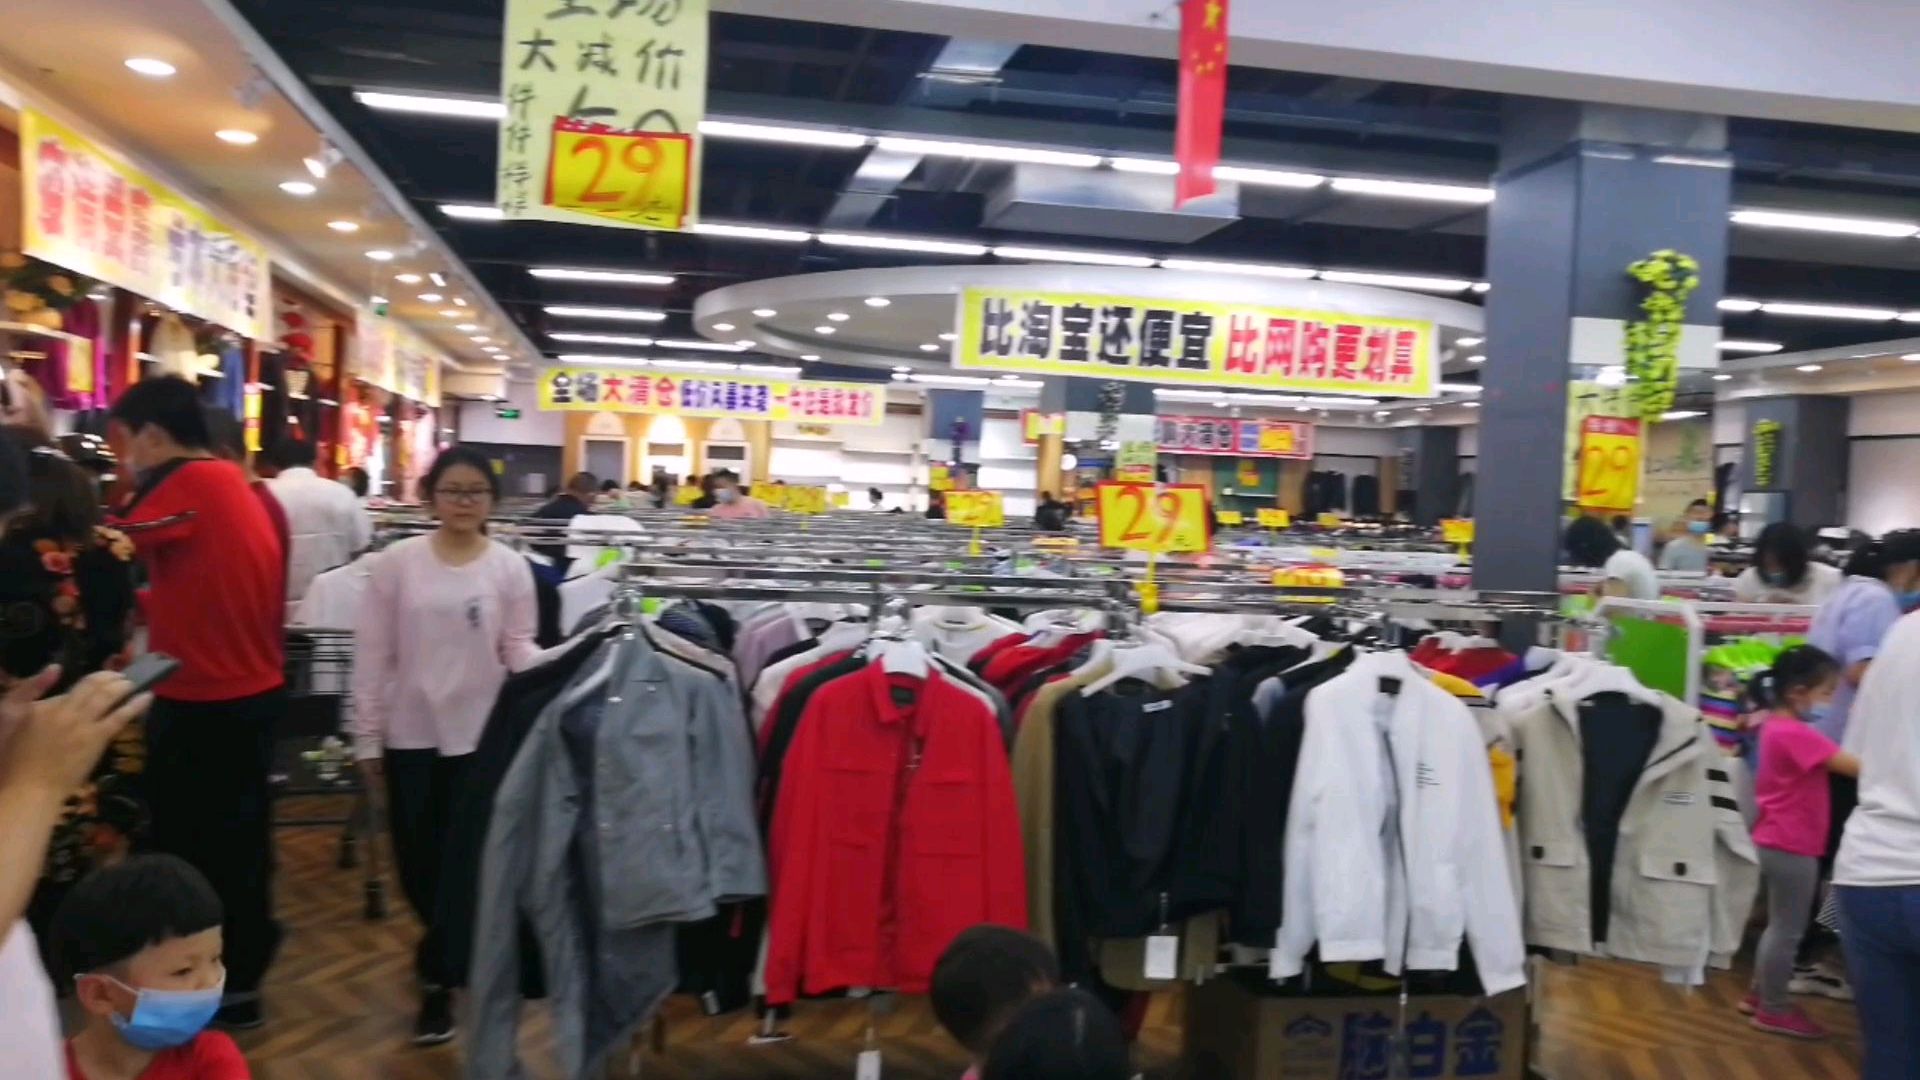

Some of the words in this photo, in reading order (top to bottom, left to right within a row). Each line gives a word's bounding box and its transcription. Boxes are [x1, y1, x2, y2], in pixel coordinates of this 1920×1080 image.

[571, 137, 664, 205] 29
[980, 297, 1213, 371] 比淘宝还便宜
[1224, 313, 1417, 384] 比网购更划算
[1117, 485, 1183, 543] 29
[1341, 1006, 1505, 1080] 脑白金
